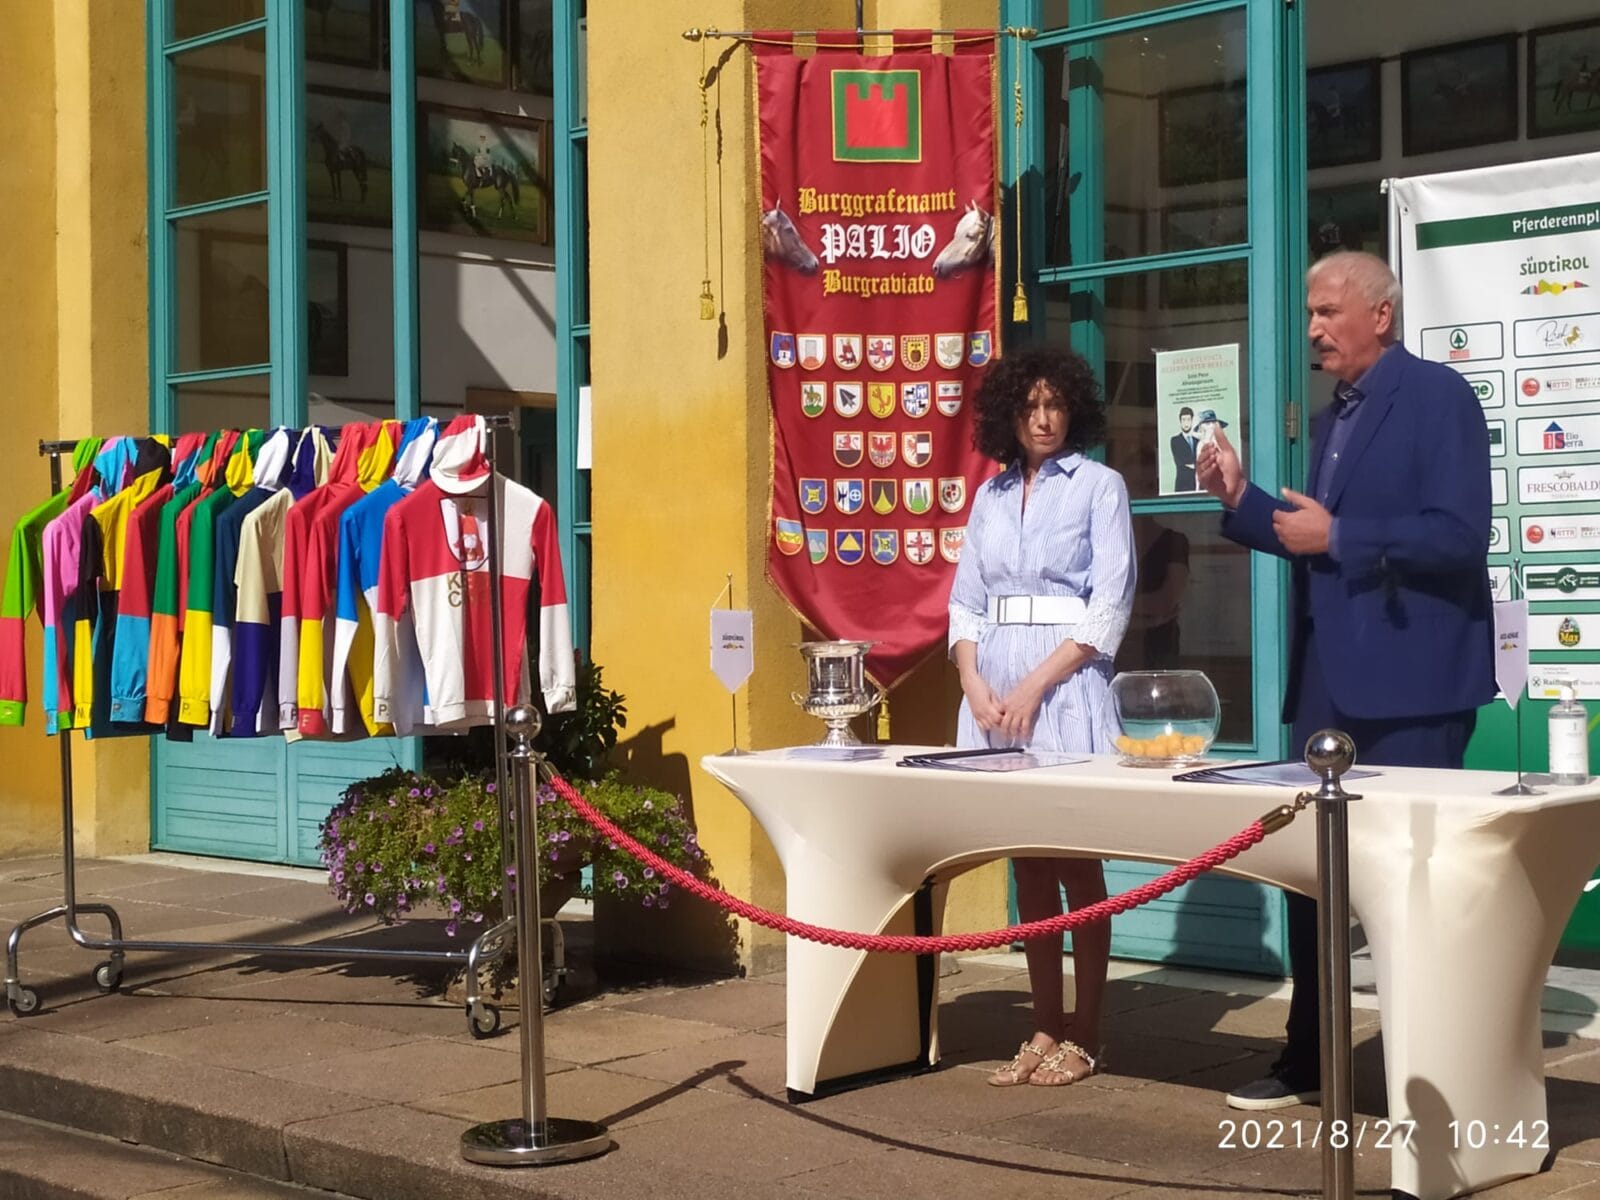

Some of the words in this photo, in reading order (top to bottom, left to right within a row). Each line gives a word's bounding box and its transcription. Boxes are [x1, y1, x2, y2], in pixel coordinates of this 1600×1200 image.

[798, 187, 957, 218] Burggrafenamt
[819, 223, 937, 264] PALIO
[822, 269, 936, 298] Burgraviato
